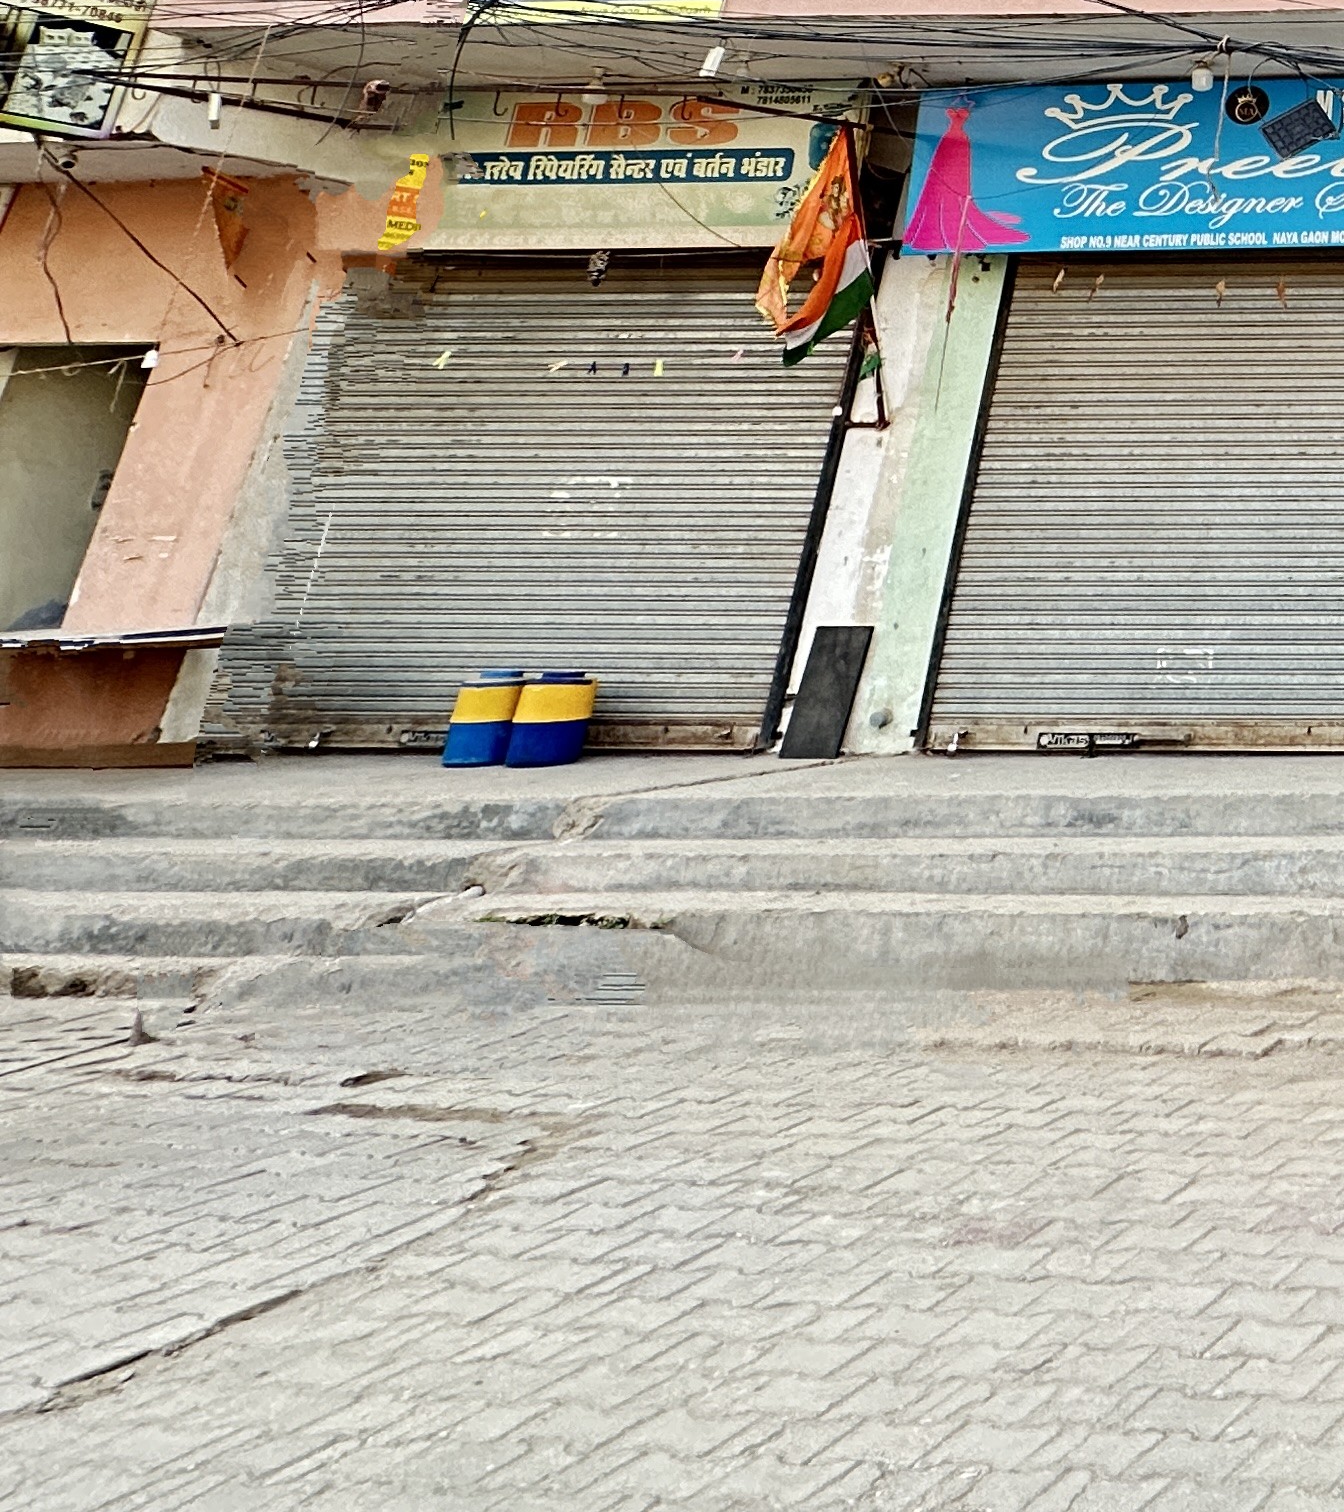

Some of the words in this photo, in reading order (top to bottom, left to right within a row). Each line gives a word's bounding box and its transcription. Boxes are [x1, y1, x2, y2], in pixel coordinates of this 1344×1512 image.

[505, 98, 741, 148] RBS
[660, 152, 685, 179] एवं
[740, 151, 786, 178] भंडार
[1053, 182, 1128, 219] The
[1132, 181, 1303, 228] Designer
[1060, 235, 1087, 249] SHOP
[1114, 234, 1140, 248] NEAR
[1142, 234, 1188, 247] CENTURY
[1191, 233, 1227, 246] PUBLIC
[1228, 231, 1268, 245] SCHOOL
[1272, 231, 1298, 244] NAYA
[1300, 231, 1329, 244] GAON
